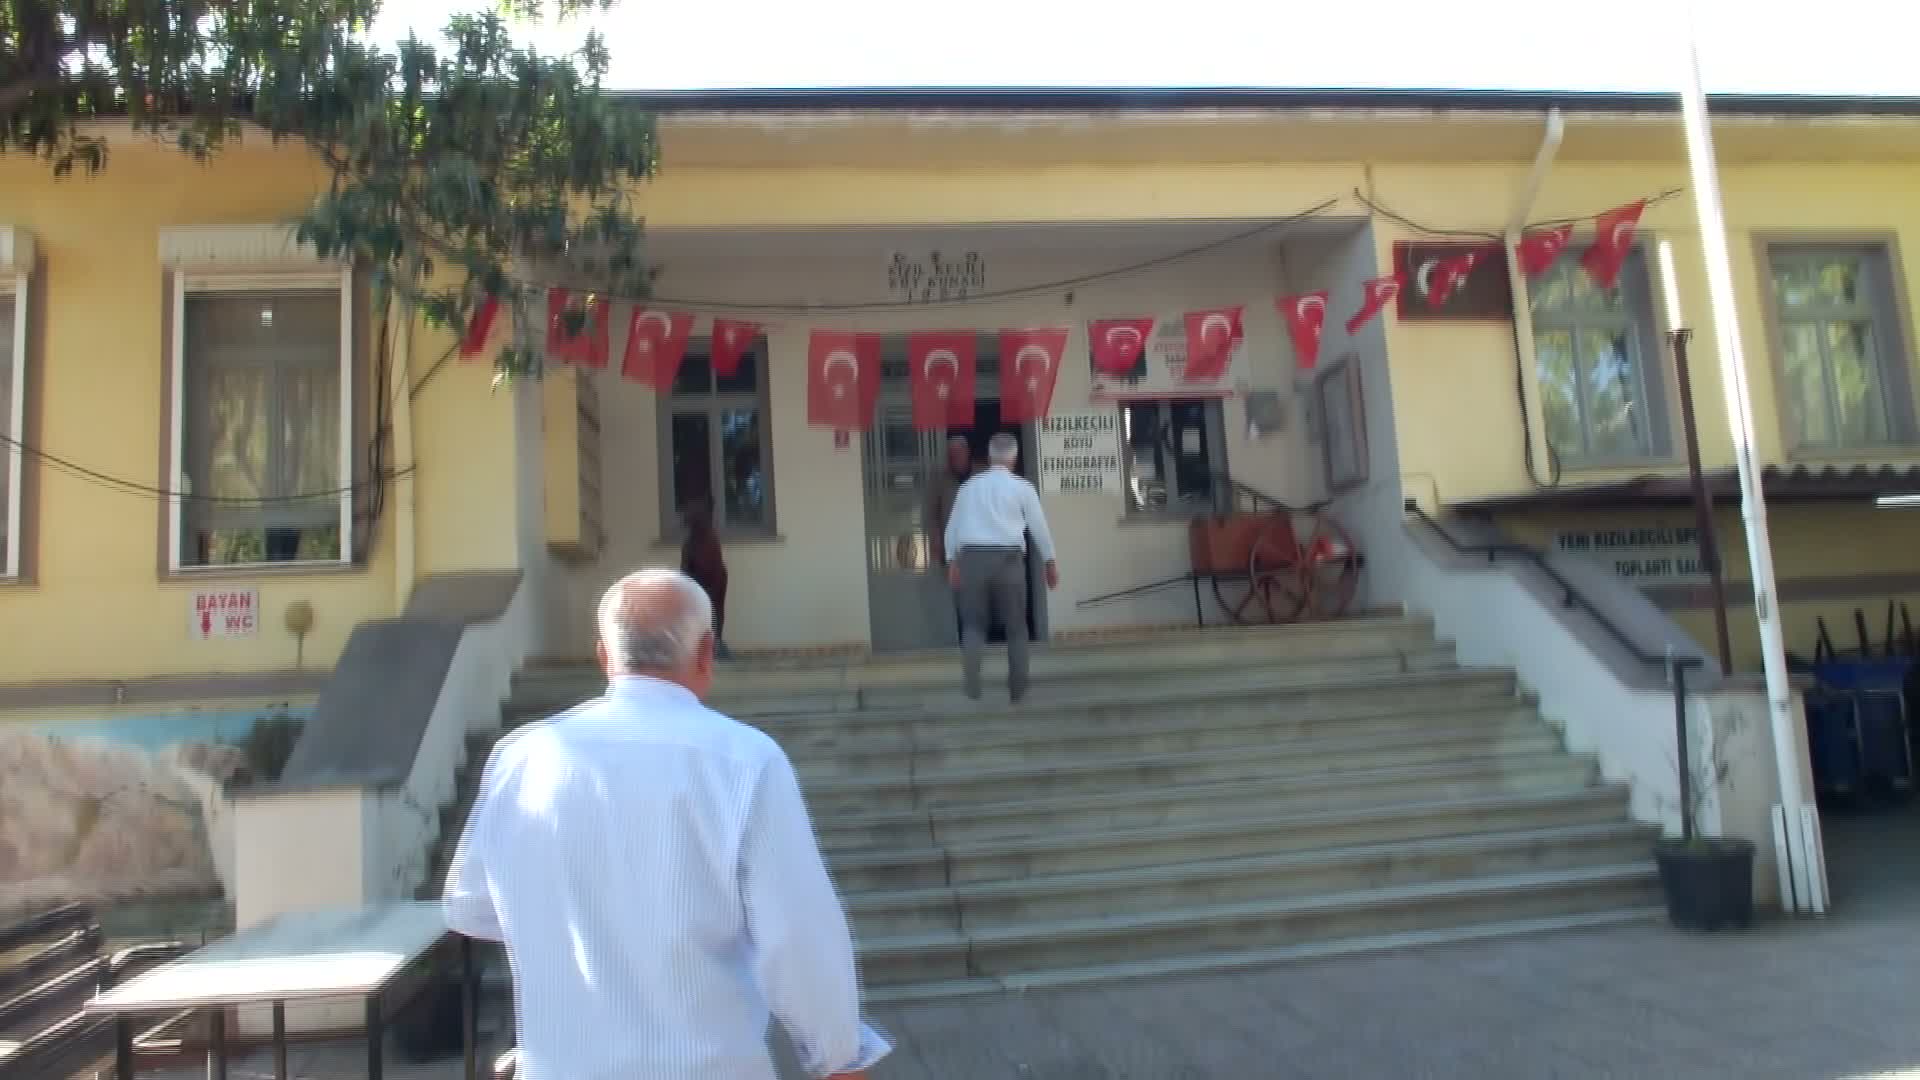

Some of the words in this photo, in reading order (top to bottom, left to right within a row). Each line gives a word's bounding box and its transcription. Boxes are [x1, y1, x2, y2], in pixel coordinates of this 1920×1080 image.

[1043, 456, 1117, 472] ETNOGRAFYA
[196, 592, 251, 611] BAYAN
[225, 615, 253, 630] WC
